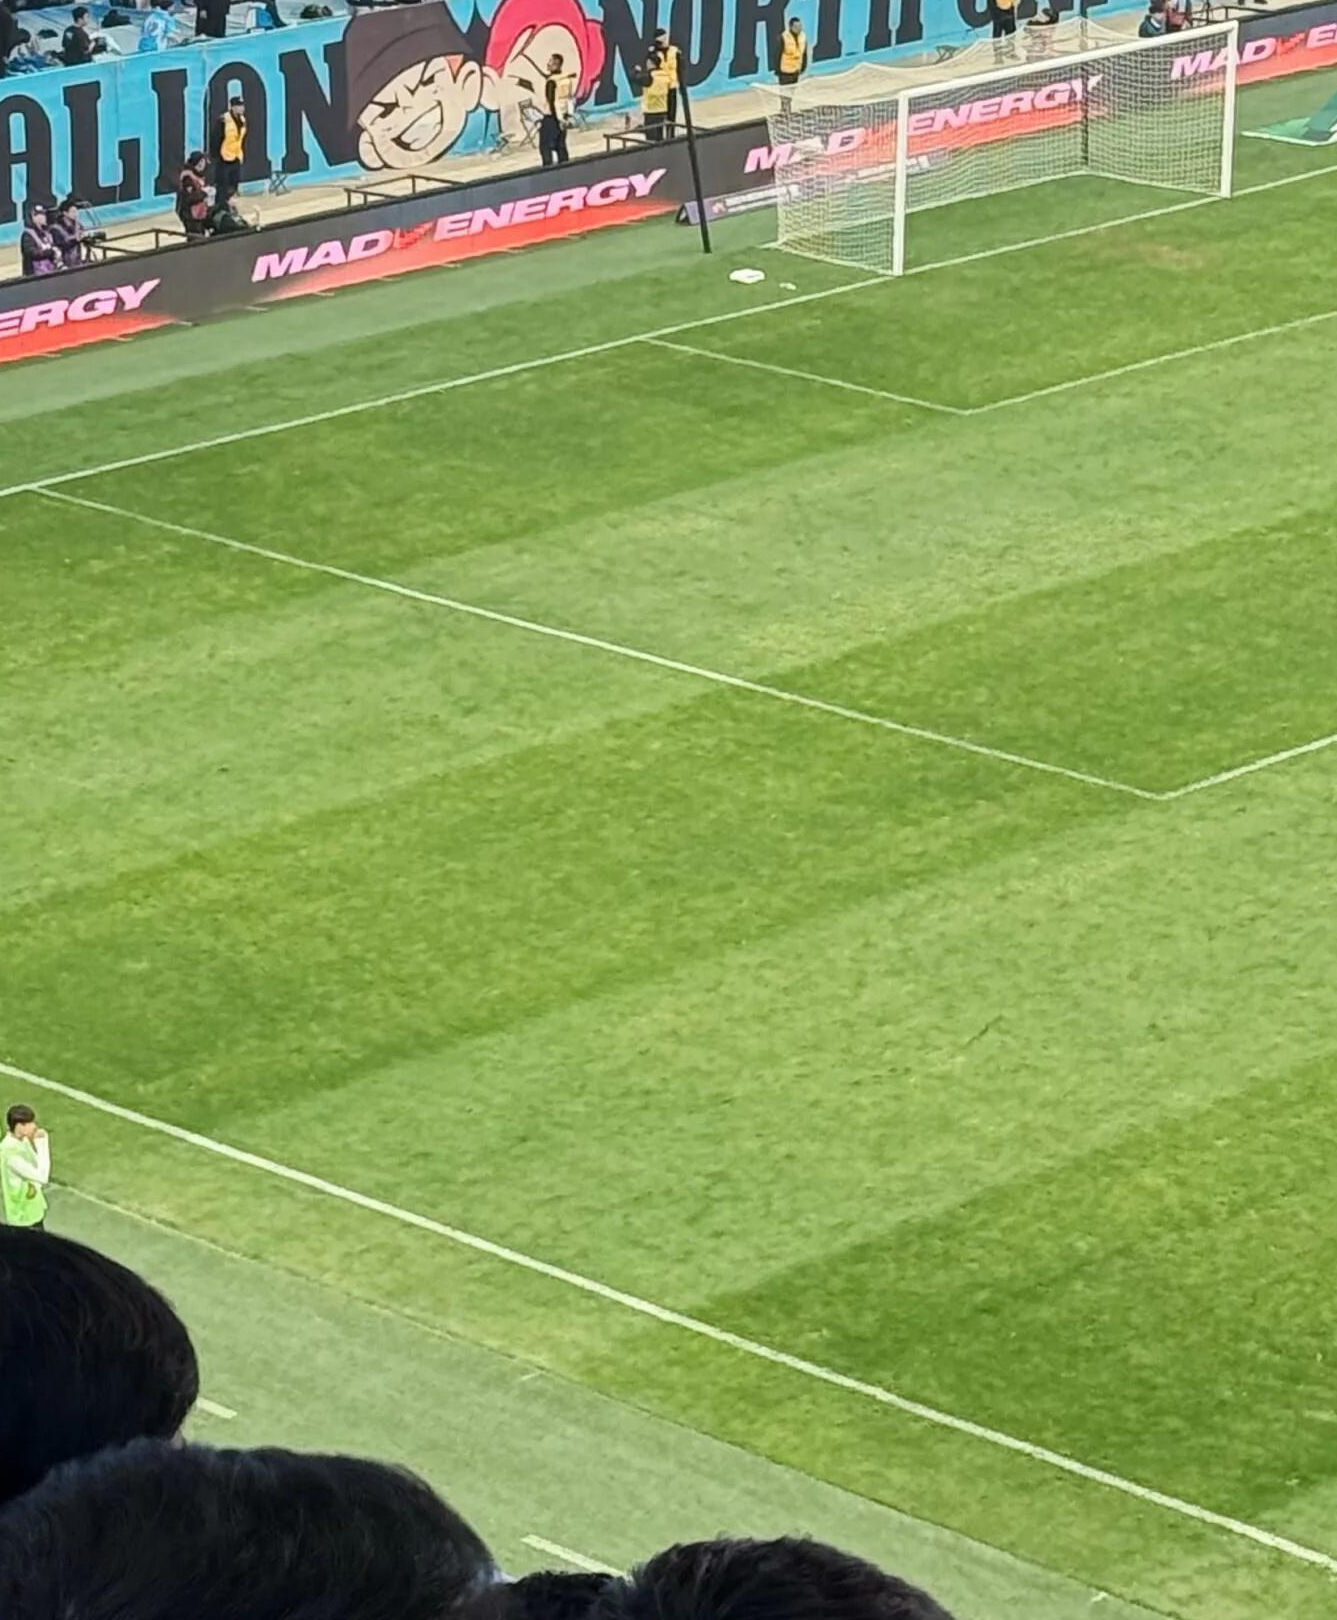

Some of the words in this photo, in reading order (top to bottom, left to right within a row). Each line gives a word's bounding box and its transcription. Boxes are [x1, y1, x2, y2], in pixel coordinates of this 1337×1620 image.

[1170, 36, 1276, 80] MAD
[743, 129, 865, 173] MAD
[908, 74, 1103, 132] ENERGY
[251, 227, 395, 282] MAD
[433, 168, 668, 242] ENERGY
